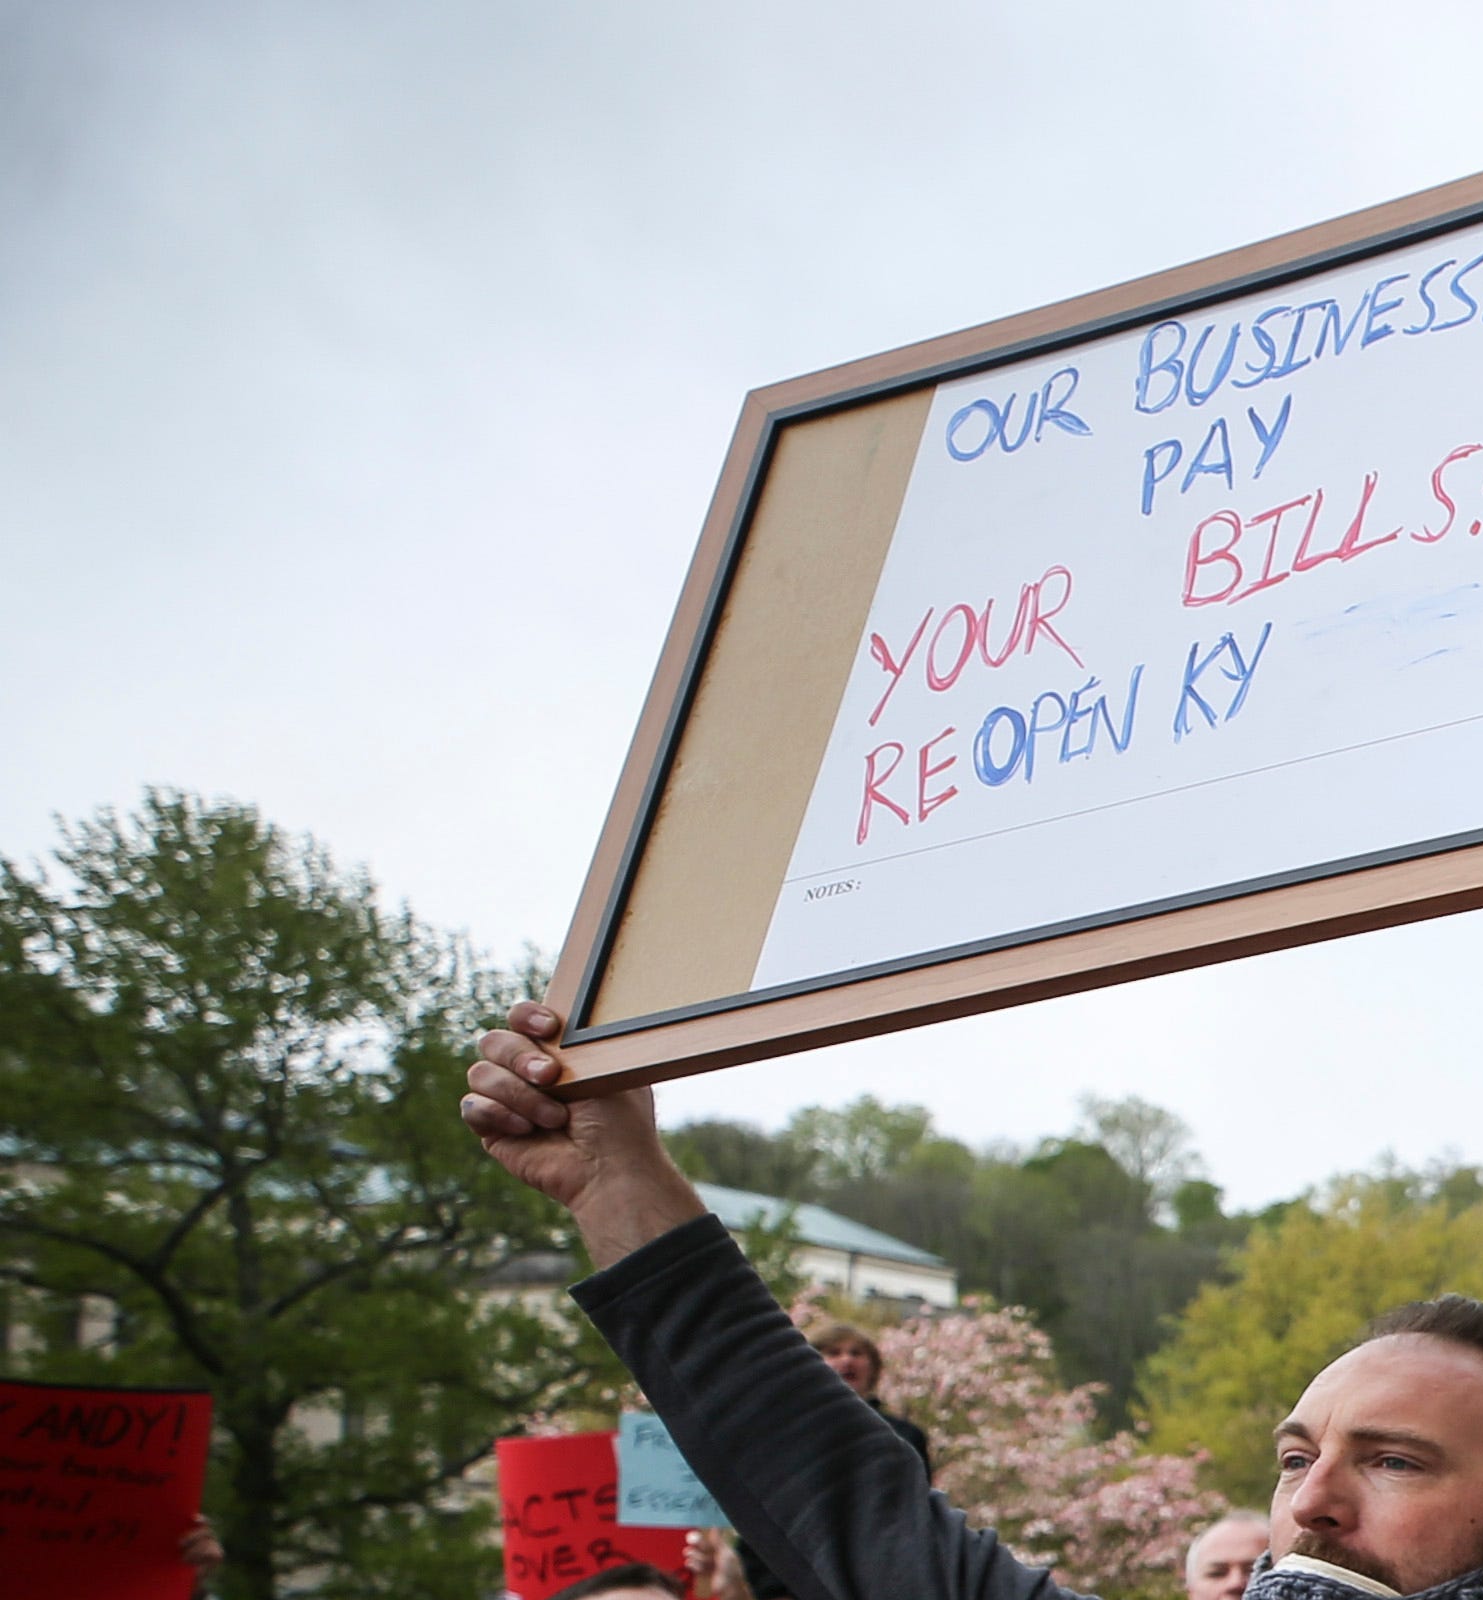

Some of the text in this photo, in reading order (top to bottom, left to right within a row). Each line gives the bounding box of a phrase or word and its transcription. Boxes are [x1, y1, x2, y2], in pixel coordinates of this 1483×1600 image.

[945, 366, 1092, 462] OUR
[1141, 395, 1292, 516] PAY
[869, 565, 1085, 727] YOUR
[1173, 622, 1272, 743] KY
[804, 879, 862, 902] NOTES:
[17, 1402, 188, 1457] ANDY!
